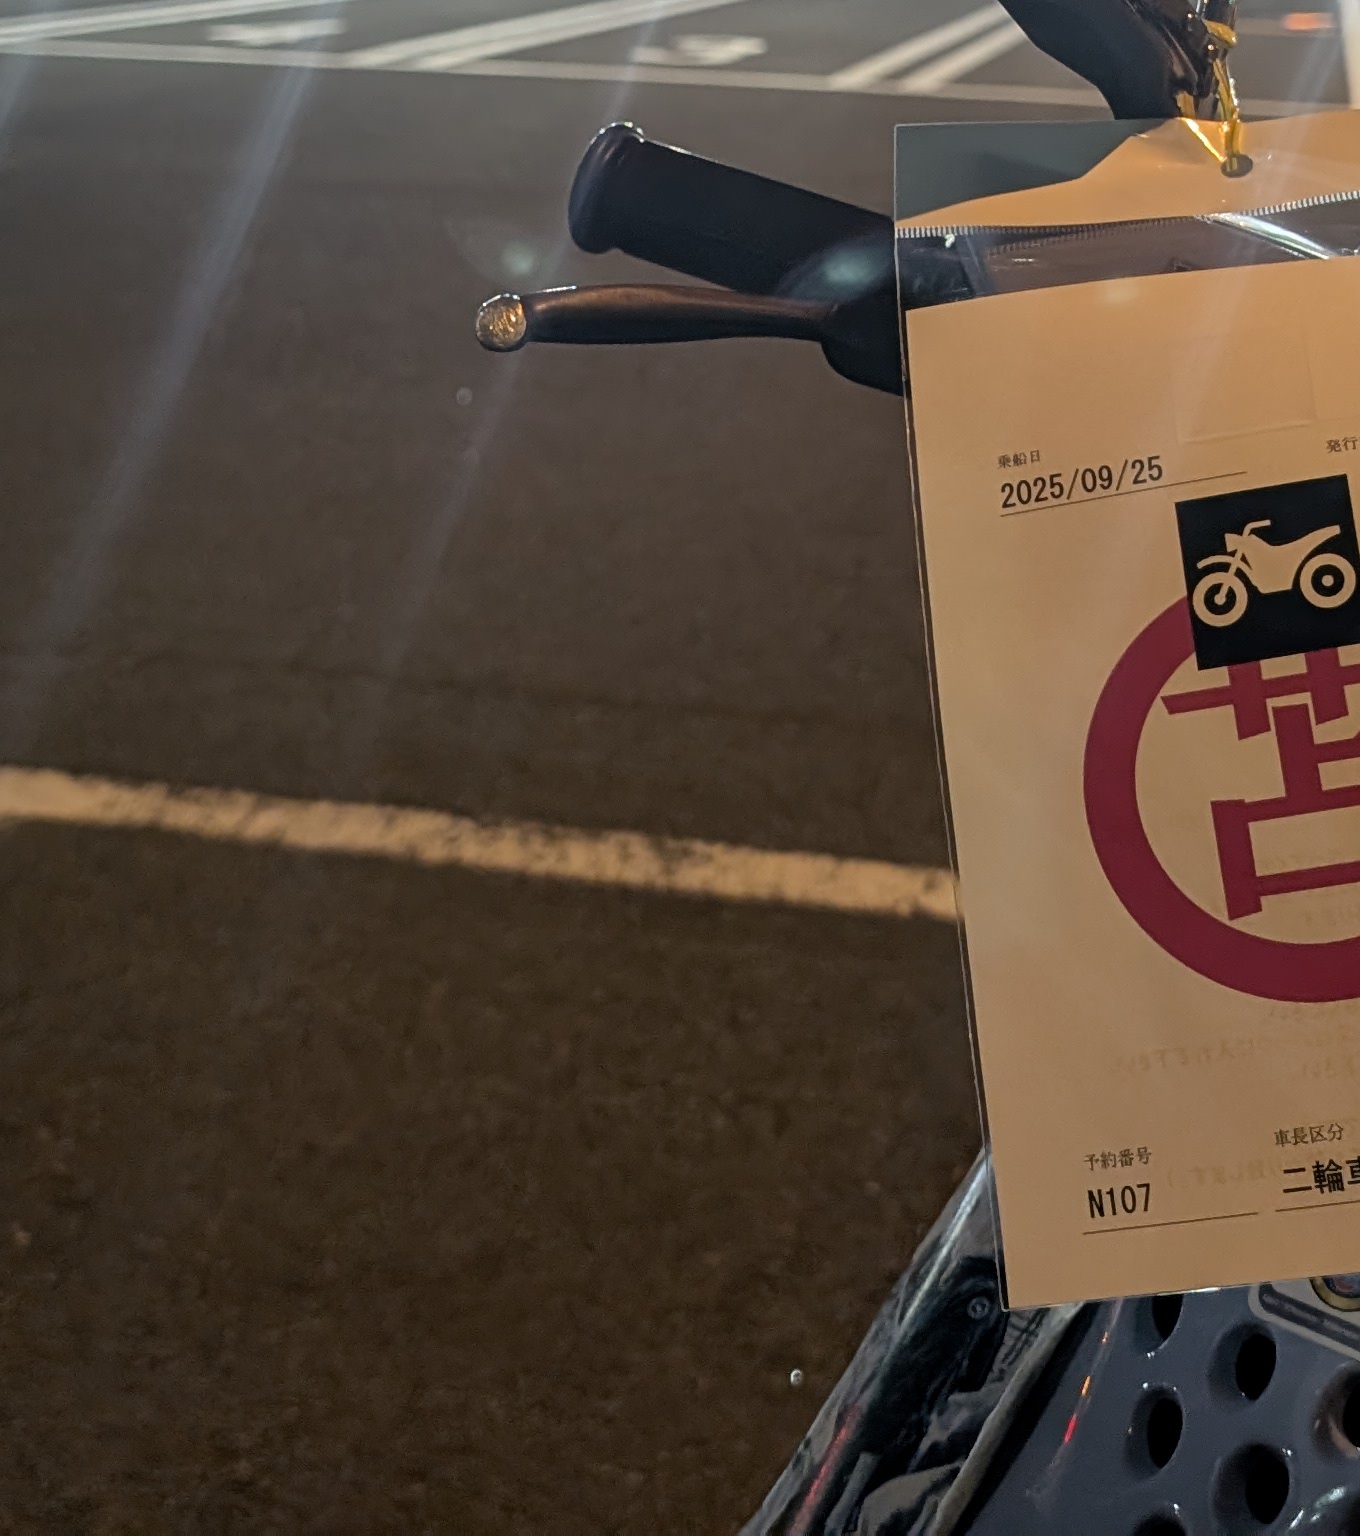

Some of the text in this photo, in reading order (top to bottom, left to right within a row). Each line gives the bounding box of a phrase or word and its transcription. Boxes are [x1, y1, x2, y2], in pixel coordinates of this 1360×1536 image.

[997, 449, 1042, 470] 乗船日
[1000, 455, 1164, 509] 2025/09/25
[1274, 1121, 1345, 1148] 車長区分
[1084, 1145, 1153, 1172] 予約番号
[1087, 1182, 1151, 1219] N107
